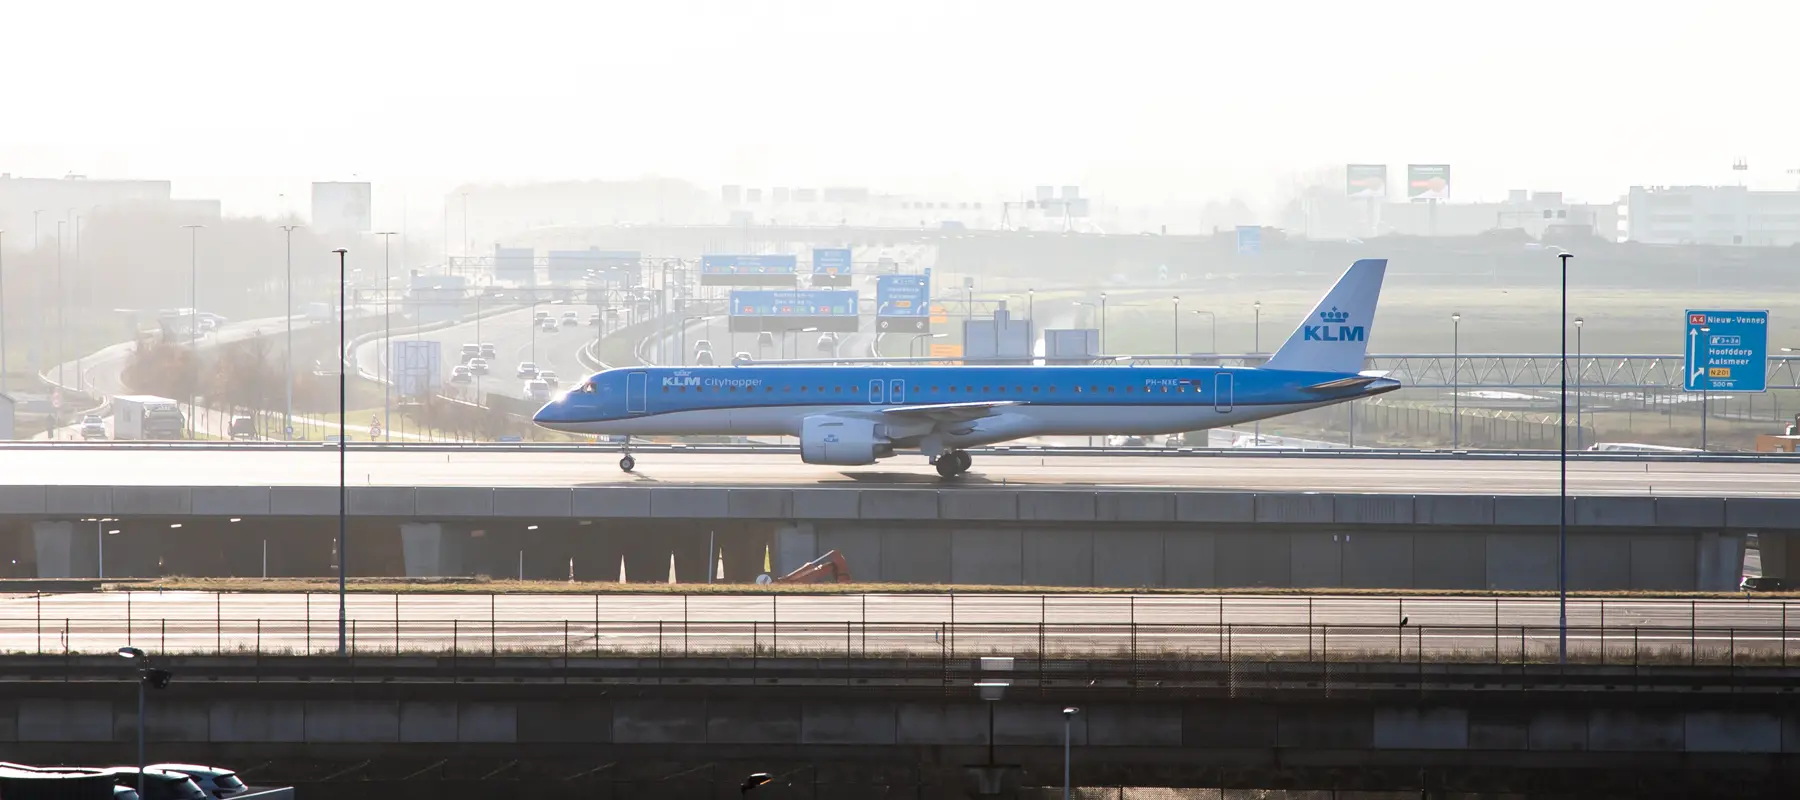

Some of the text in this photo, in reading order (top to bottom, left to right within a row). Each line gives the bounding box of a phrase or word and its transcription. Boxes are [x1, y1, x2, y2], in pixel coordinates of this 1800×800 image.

[1708, 316, 1765, 324] Nieuw-Vennep
[1304, 325, 1364, 341] KLM
[1708, 348, 1752, 356] Hoofddorp
[662, 377, 762, 388] KLM Cityhopper
